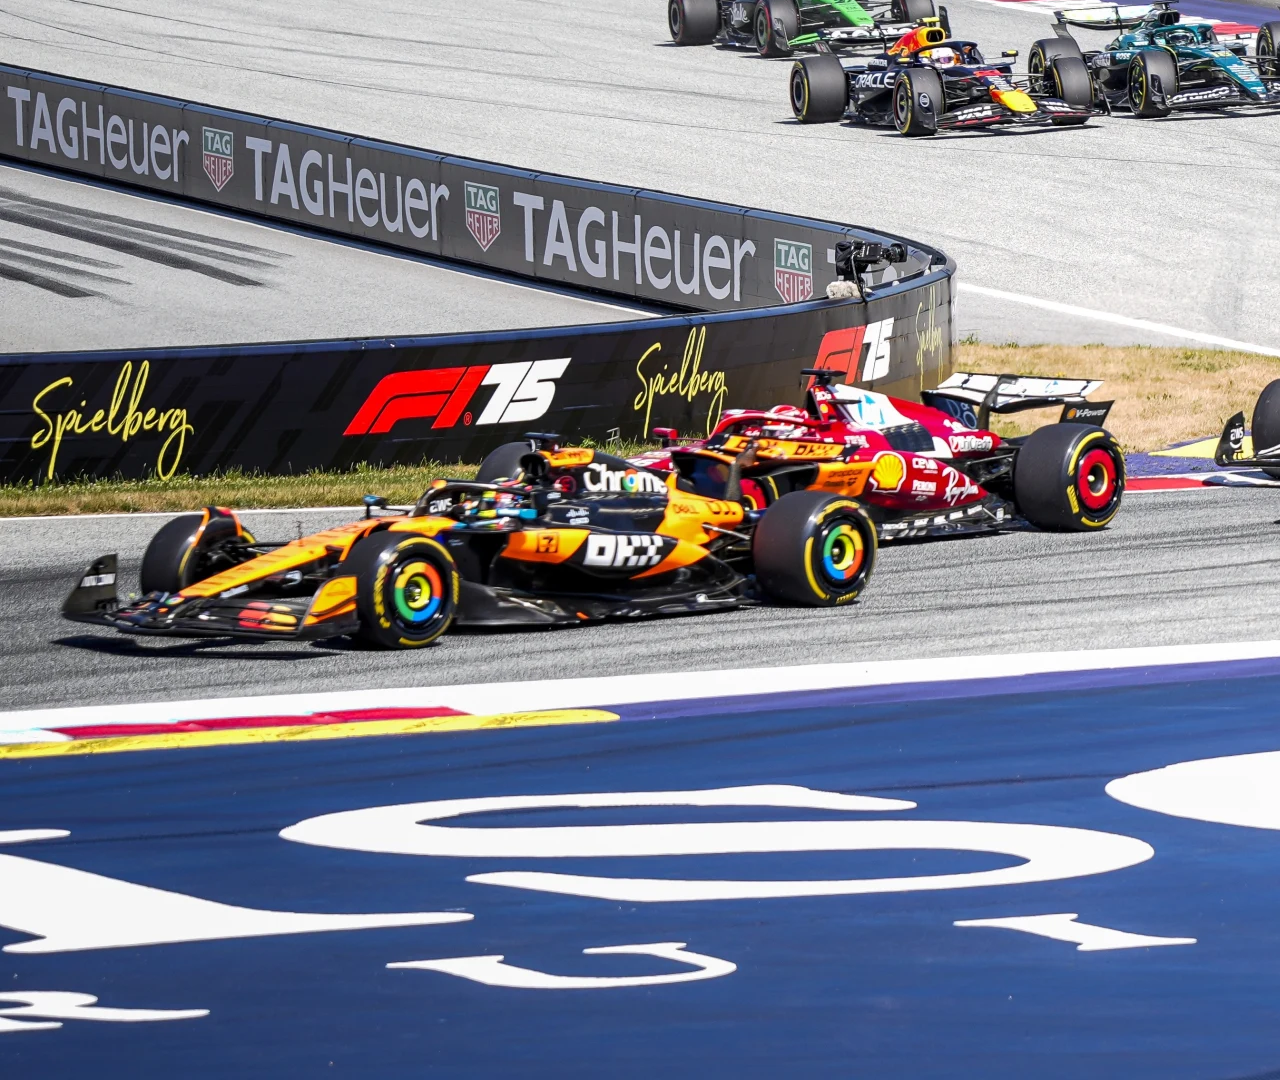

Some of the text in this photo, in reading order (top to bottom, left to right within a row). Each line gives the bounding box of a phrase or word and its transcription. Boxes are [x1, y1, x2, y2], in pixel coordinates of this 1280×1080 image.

[855, 72, 895, 89] ORACLE
[1172, 87, 1230, 102] aramco
[7, 86, 190, 183] TAGHeuer
[205, 132, 232, 154] TAG
[204, 153, 234, 186] HEUER
[245, 136, 450, 240] TAGHeuer
[468, 186, 498, 211] TAG
[467, 210, 500, 246] HEUER
[513, 192, 755, 302] TAGHeuer
[777, 244, 810, 271] TAG
[776, 269, 812, 302] HEUER
[862, 317, 894, 382] 75
[343, 364, 492, 432] F1
[474, 357, 572, 427] 75
[633, 326, 731, 440] Spielberg
[30, 360, 195, 481] Spielberg
[1075, 406, 1108, 419] V-Power
[583, 463, 667, 494] Chrome
[912, 480, 937, 491] PERONI
[583, 533, 664, 566] OKX
